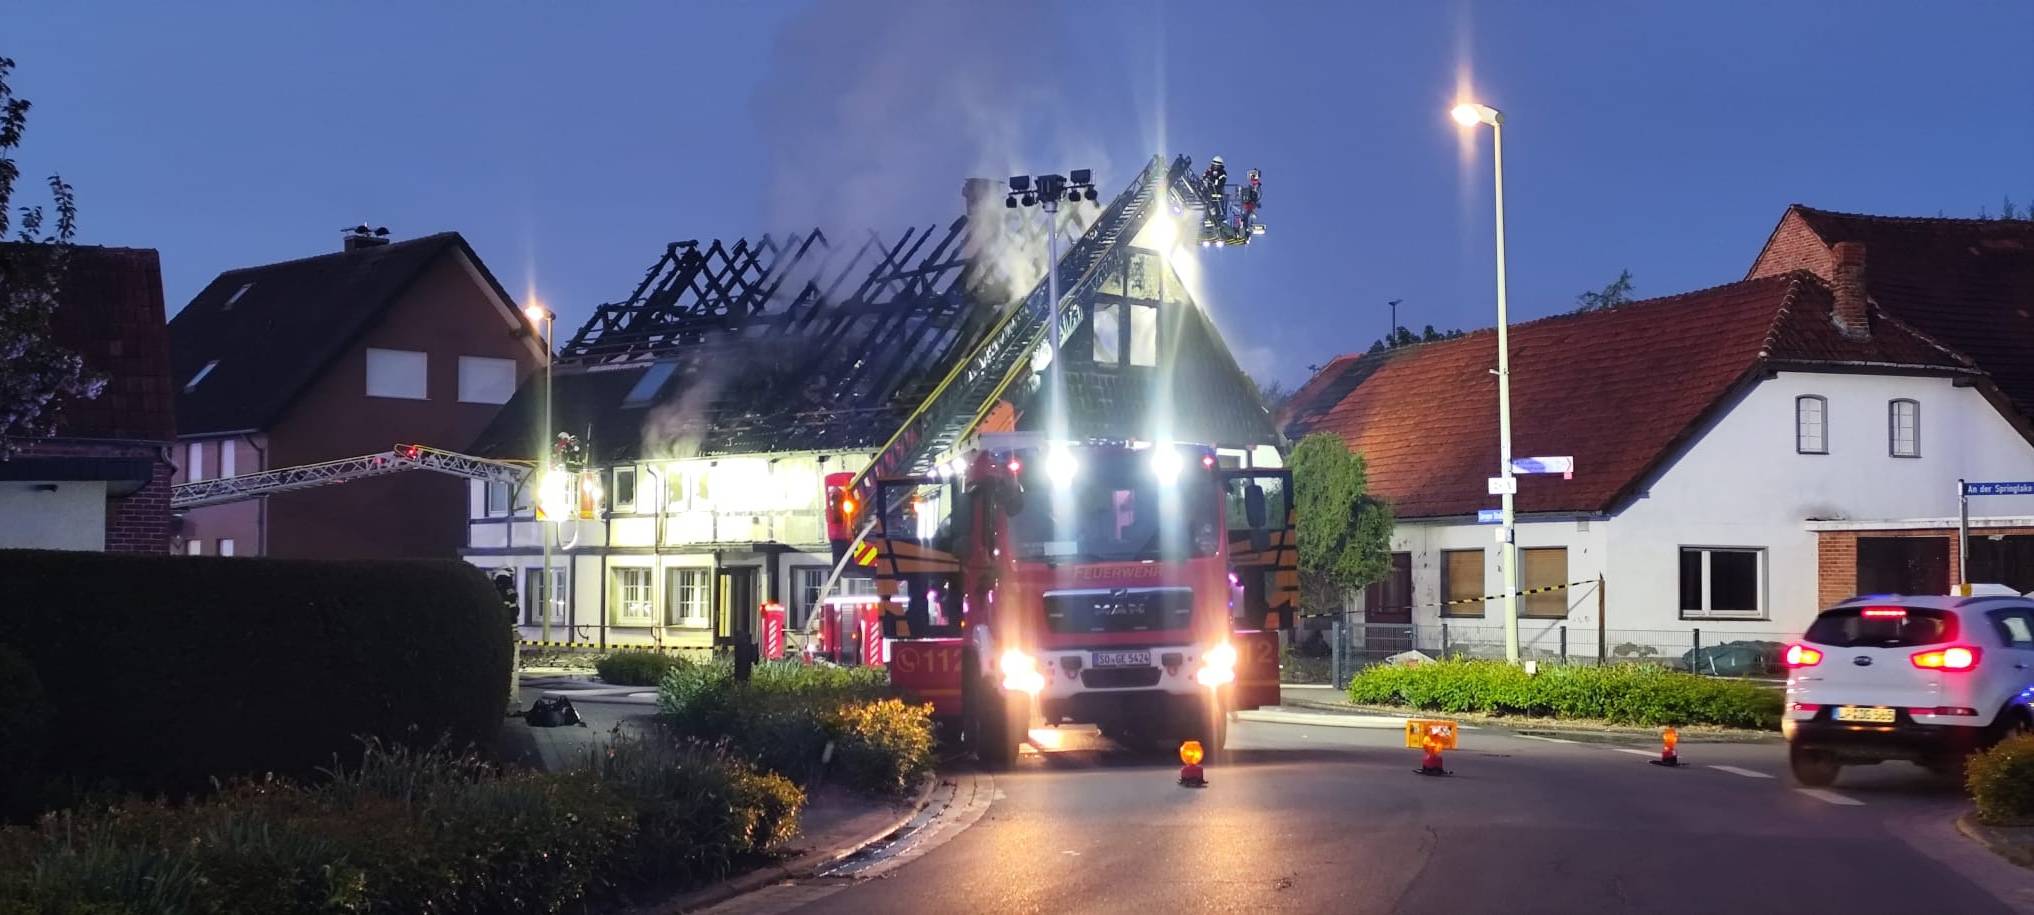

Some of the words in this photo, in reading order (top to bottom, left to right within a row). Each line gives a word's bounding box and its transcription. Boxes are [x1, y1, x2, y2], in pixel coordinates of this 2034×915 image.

[1968, 485, 1977, 493] An
[1980, 485, 1991, 493] der
[1075, 566, 1163, 578] FEUERWEHR
